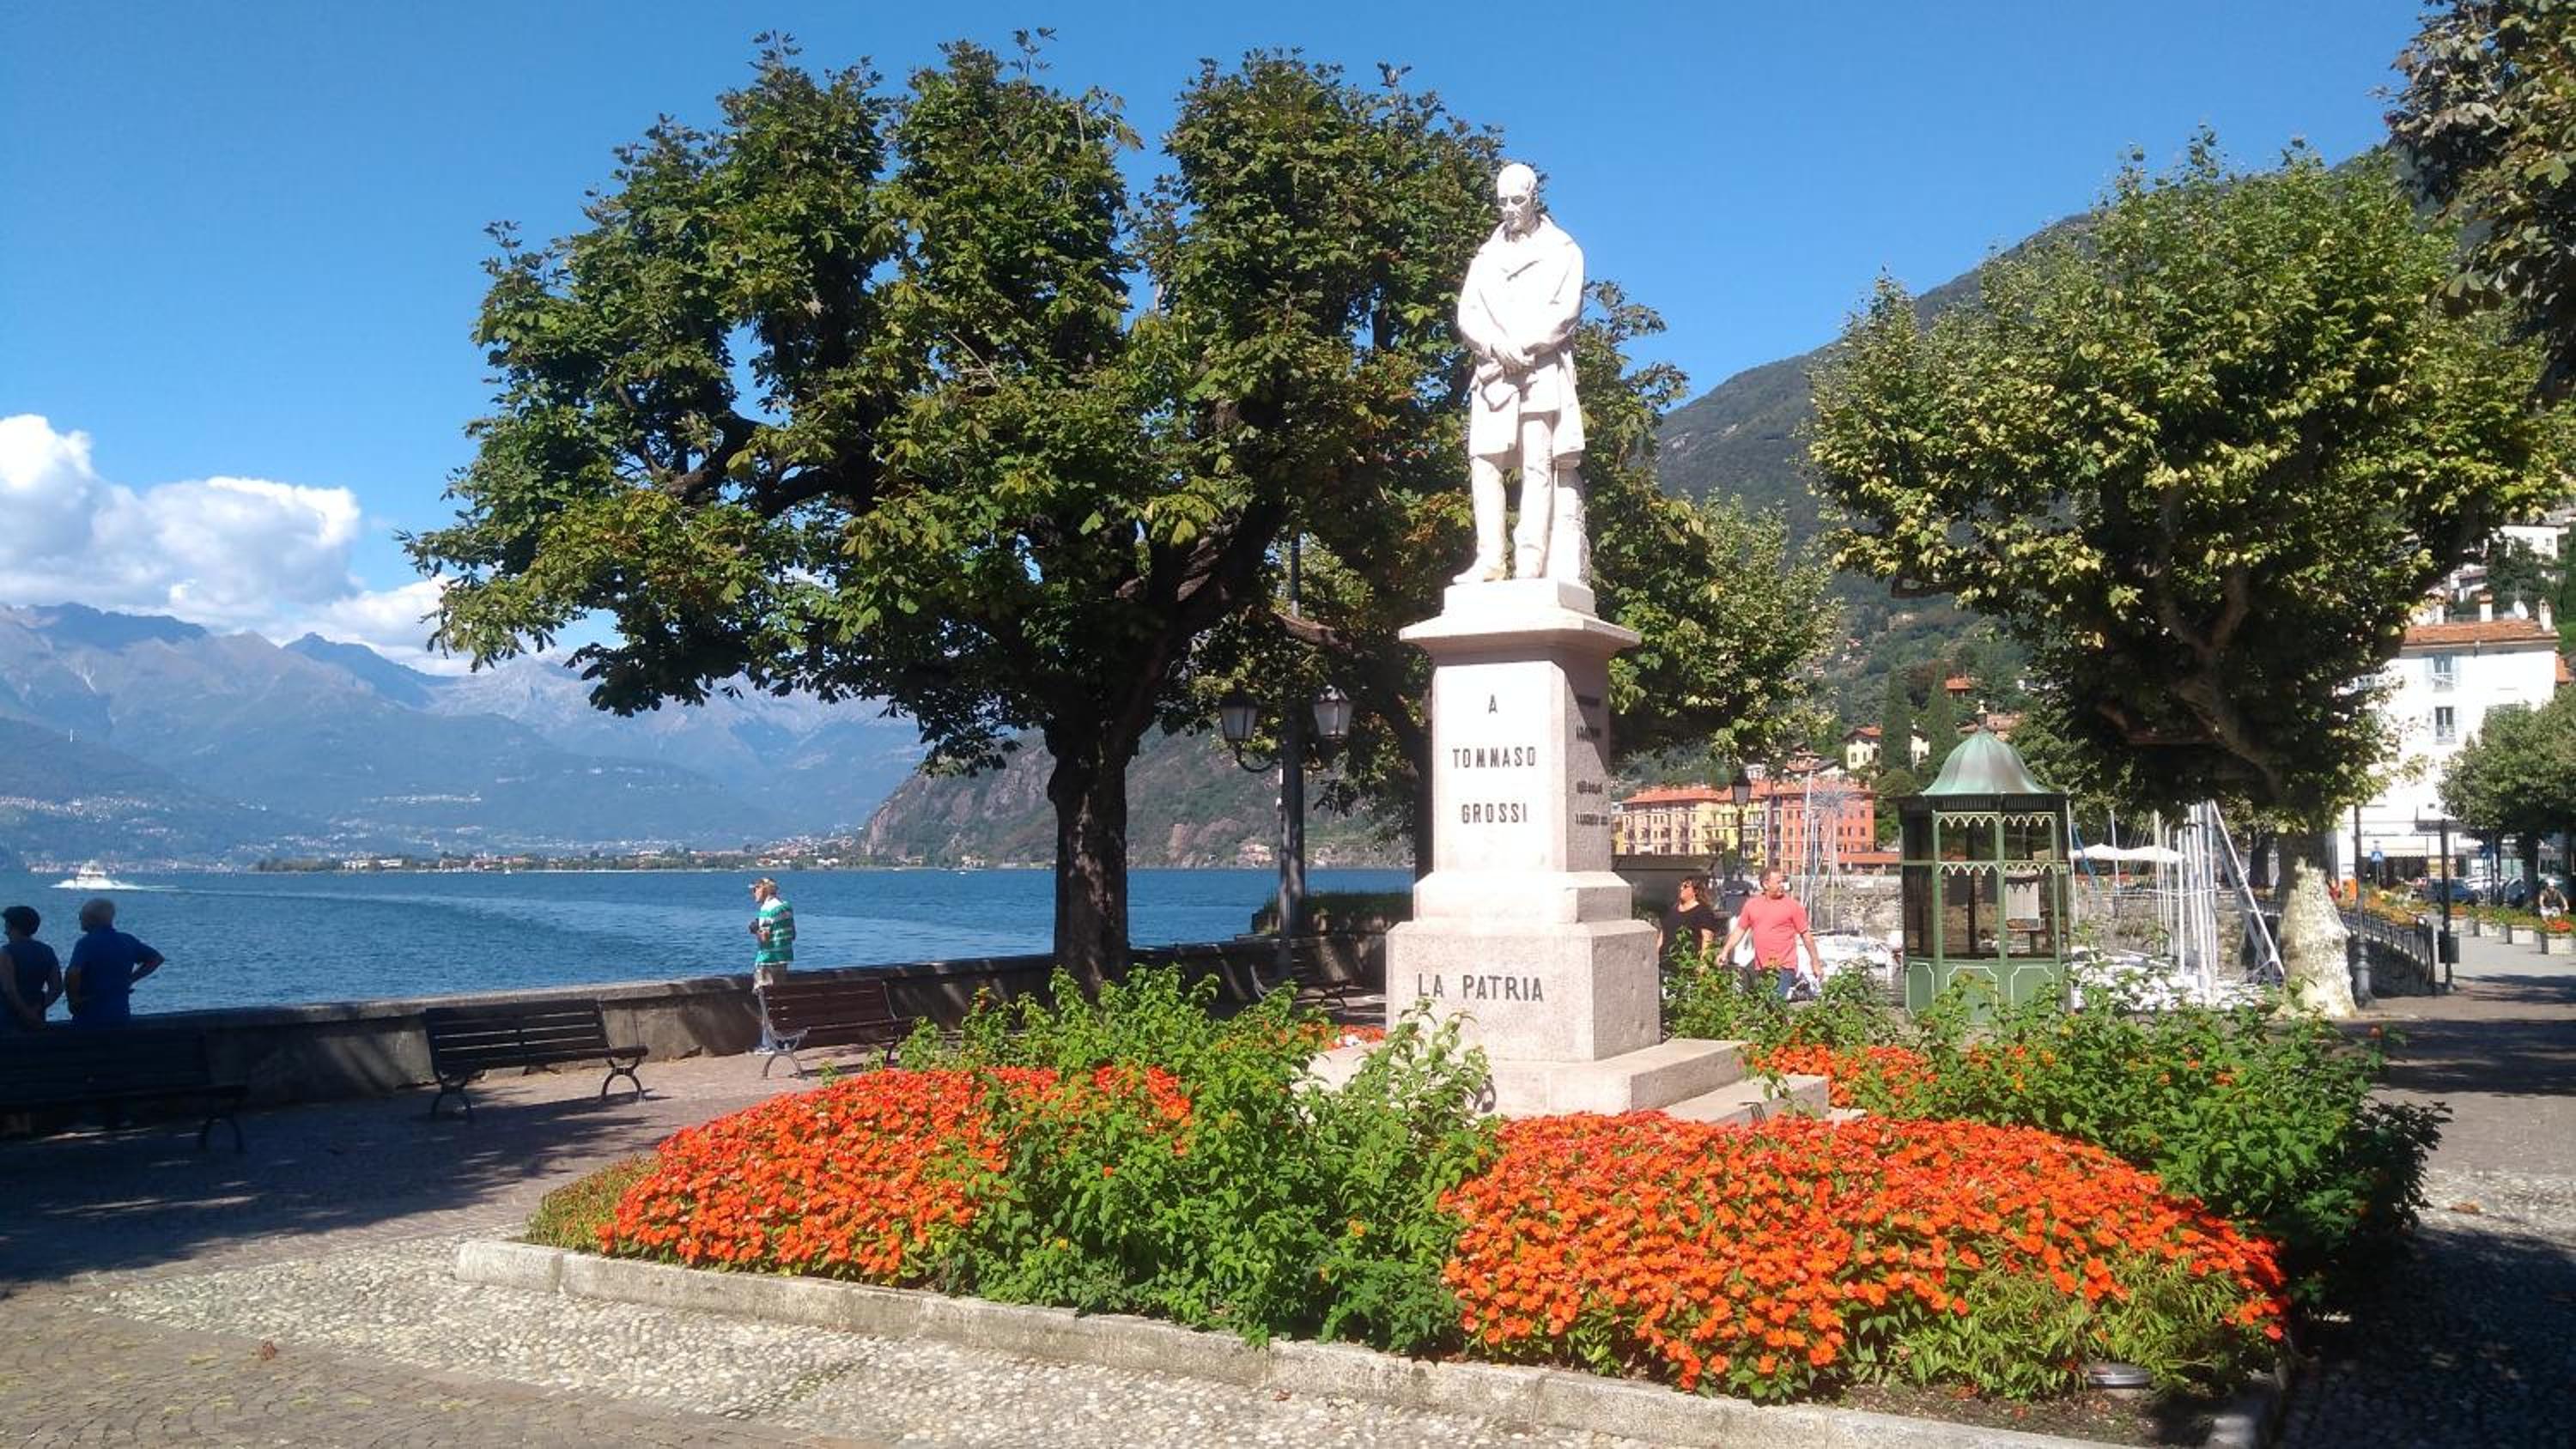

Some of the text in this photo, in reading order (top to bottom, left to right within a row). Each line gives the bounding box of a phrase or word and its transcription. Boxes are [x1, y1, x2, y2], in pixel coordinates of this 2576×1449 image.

[1487, 694, 1498, 714] A
[1452, 747, 1536, 769] TOMMASO
[1461, 803, 1528, 824] GROSSI
[1417, 973, 1544, 1003] LA PATRIA
